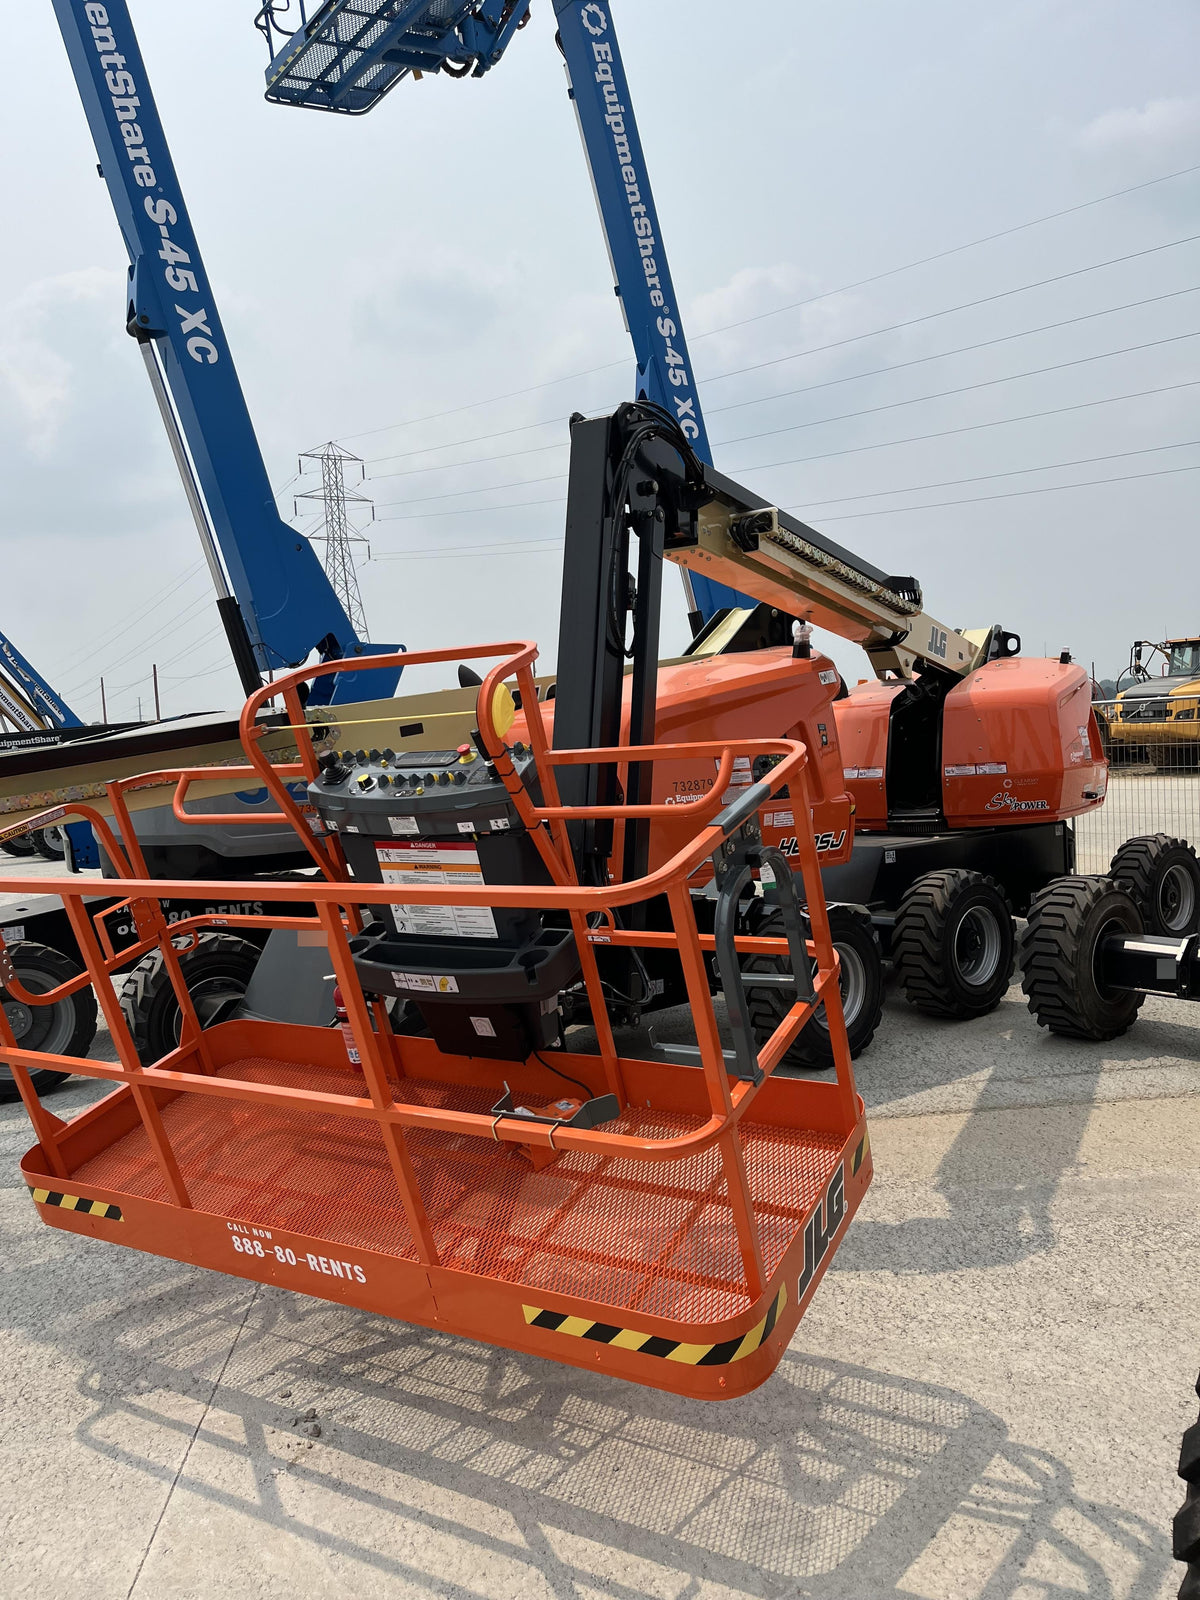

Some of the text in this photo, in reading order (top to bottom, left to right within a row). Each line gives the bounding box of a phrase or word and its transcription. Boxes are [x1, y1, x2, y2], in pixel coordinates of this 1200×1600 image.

[83, 0, 219, 366] entShare S-45 XC
[655, 315, 689, 387] S-45
[673, 396, 699, 439] XC
[928, 624, 948, 660] JLG
[672, 778, 714, 792] 732879
[4, 824, 28, 839] CAUTION
[226, 1222, 273, 1240] CALL NOW
[797, 1158, 845, 1305] JLG
[231, 1235, 367, 1284] 888-80-RENTS
